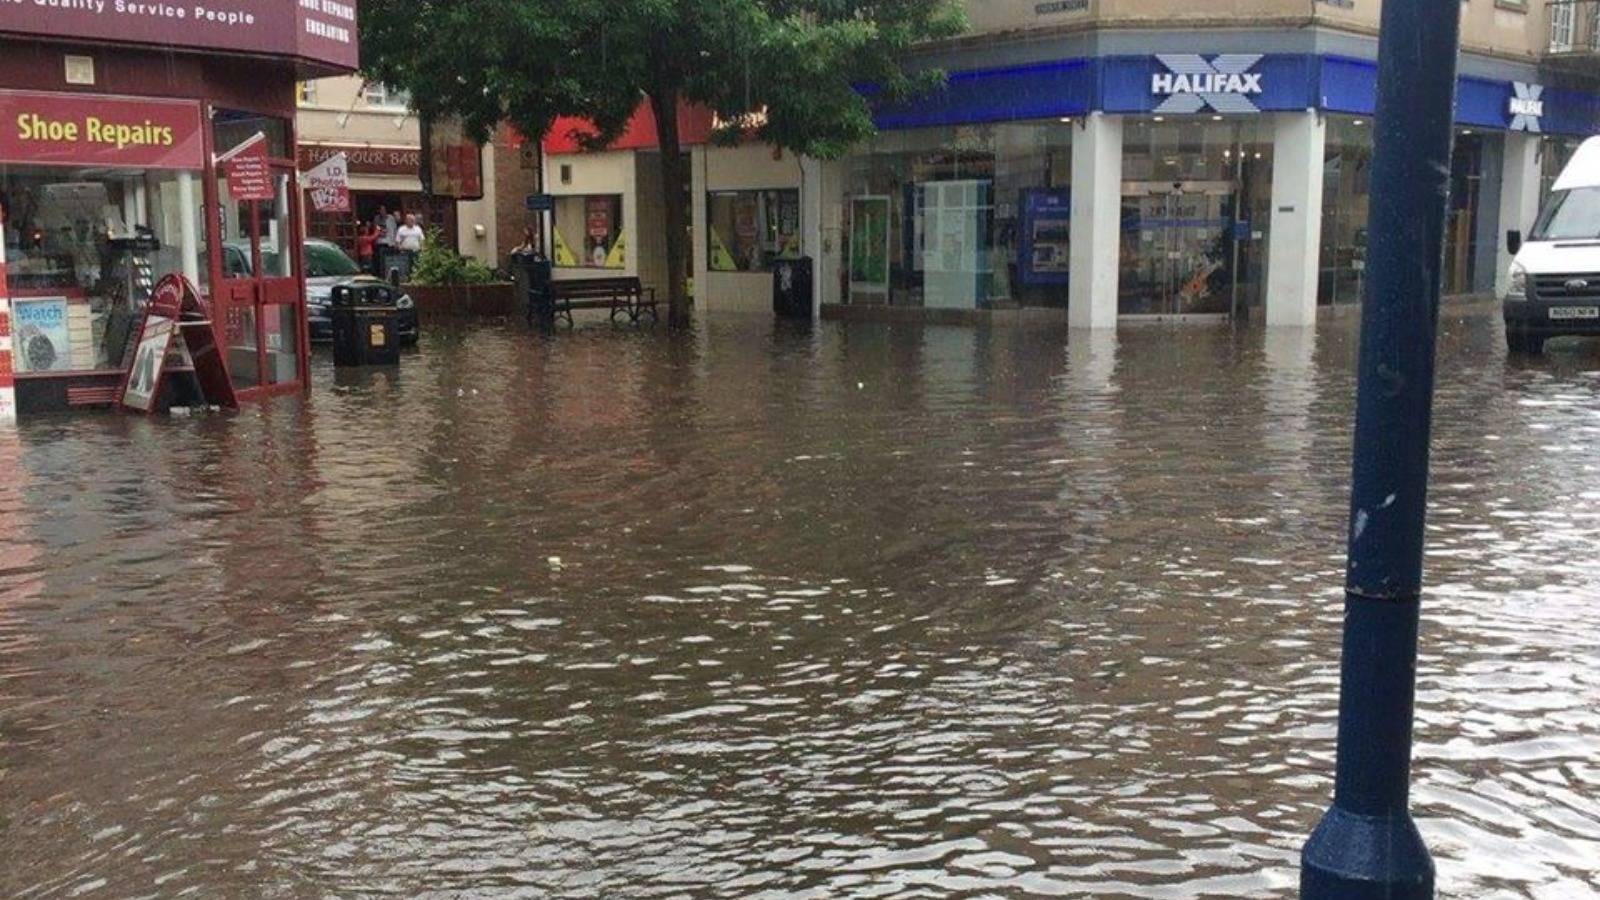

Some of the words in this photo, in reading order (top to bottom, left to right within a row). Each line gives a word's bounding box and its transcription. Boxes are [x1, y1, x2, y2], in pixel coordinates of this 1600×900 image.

[114, 0, 186, 18] Service
[194, 6, 255, 25] People
[322, 0, 354, 21] REPAIRS
[305, 18, 350, 44] ENGRAVING
[1152, 73, 1263, 93] HALIFAX
[17, 113, 78, 141] Shoe
[86, 117, 174, 149] Repairs
[389, 152, 421, 166] BAR
[310, 177, 346, 188] Photos
[18, 304, 63, 321] Watch
